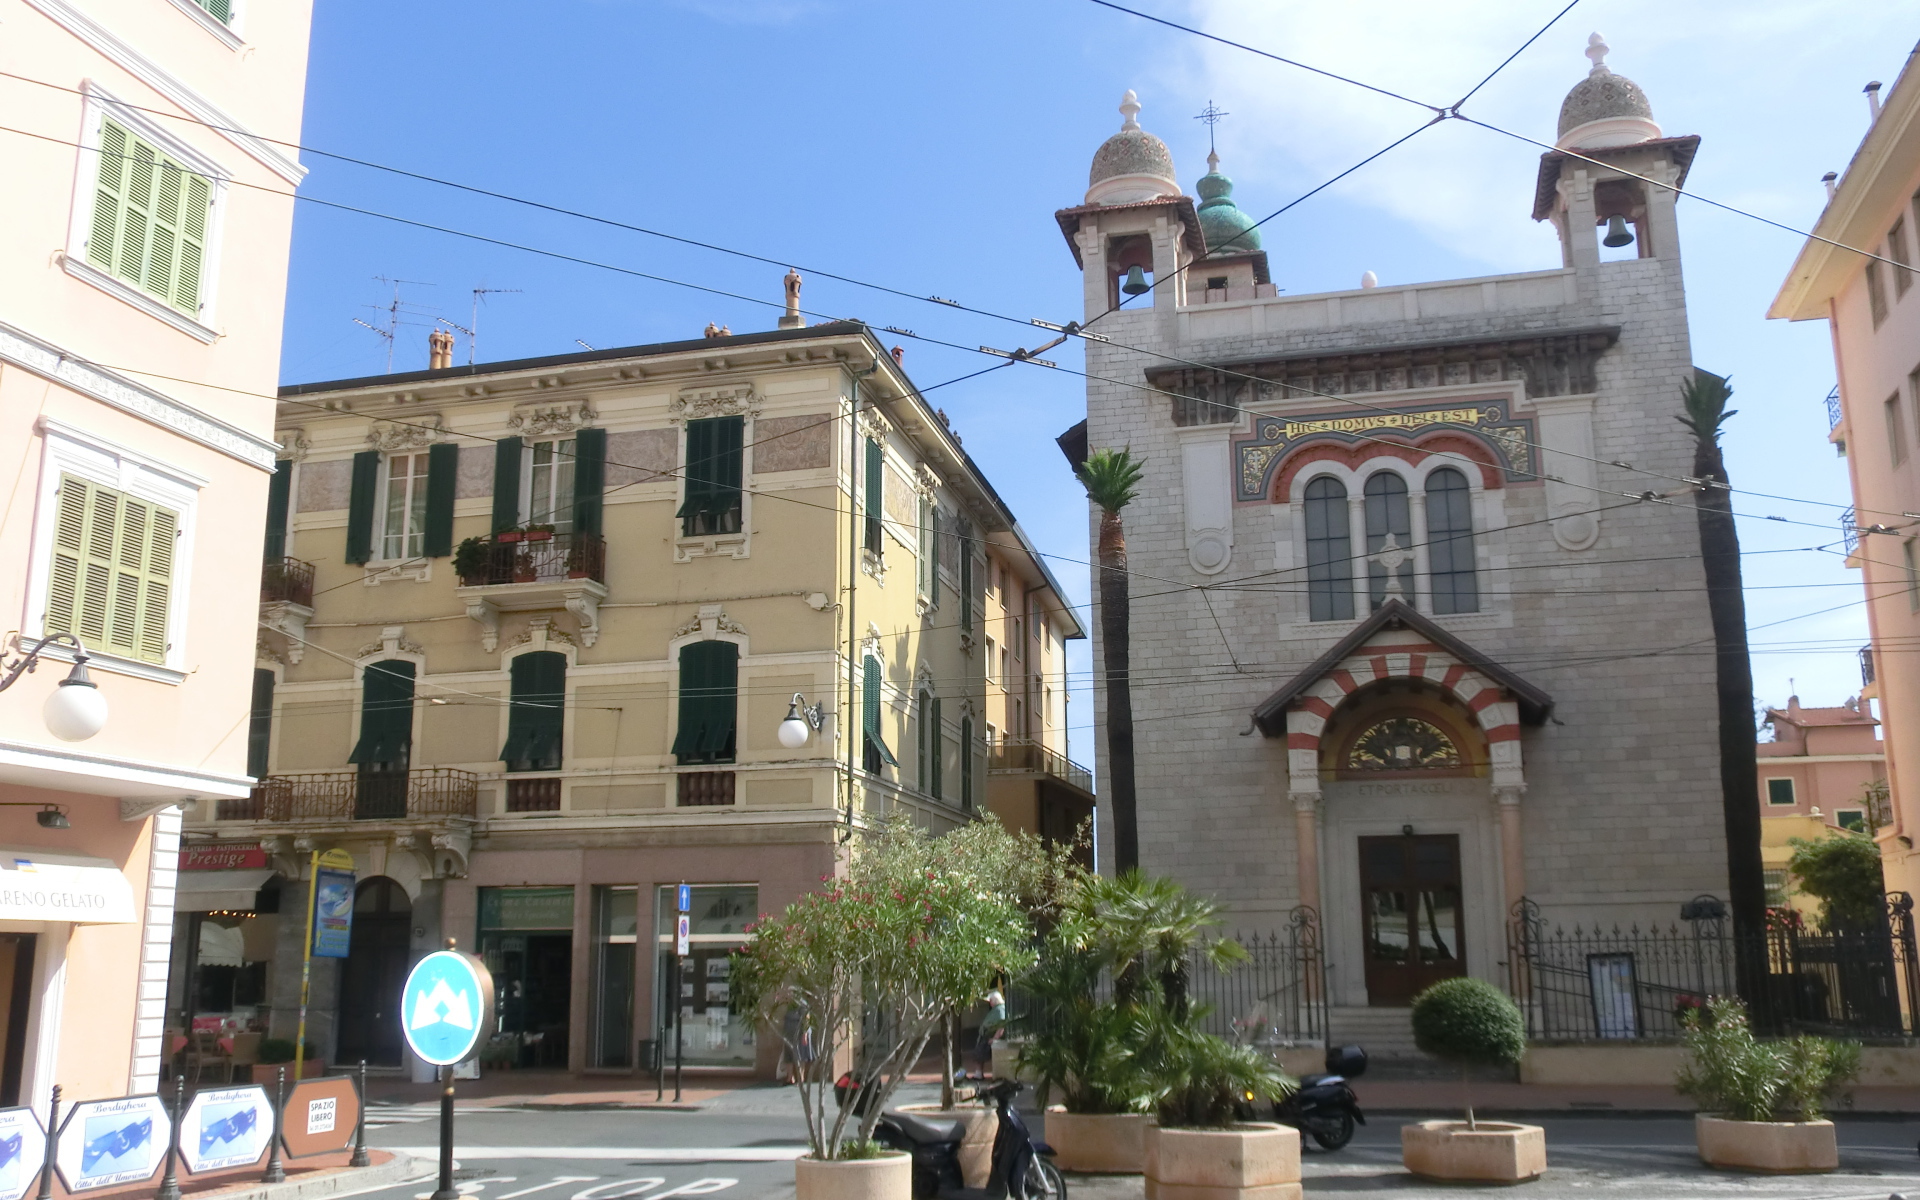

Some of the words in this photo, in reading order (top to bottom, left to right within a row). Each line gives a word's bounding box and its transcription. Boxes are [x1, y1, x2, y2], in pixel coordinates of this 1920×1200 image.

[1290, 422, 1317, 433] HIC
[1332, 416, 1386, 430] DOMVS
[1401, 413, 1426, 424] DEI
[1442, 409, 1472, 421] EST
[186, 851, 246, 868] Prestige
[50, 892, 105, 909] GELATO
[207, 1091, 252, 1102] Bordighera
[93, 1100, 147, 1113] Bordighera
[310, 1100, 335, 1111] SPAZIO
[310, 1112, 333, 1122] LIBERO
[414, 1176, 740, 1200] STOP
